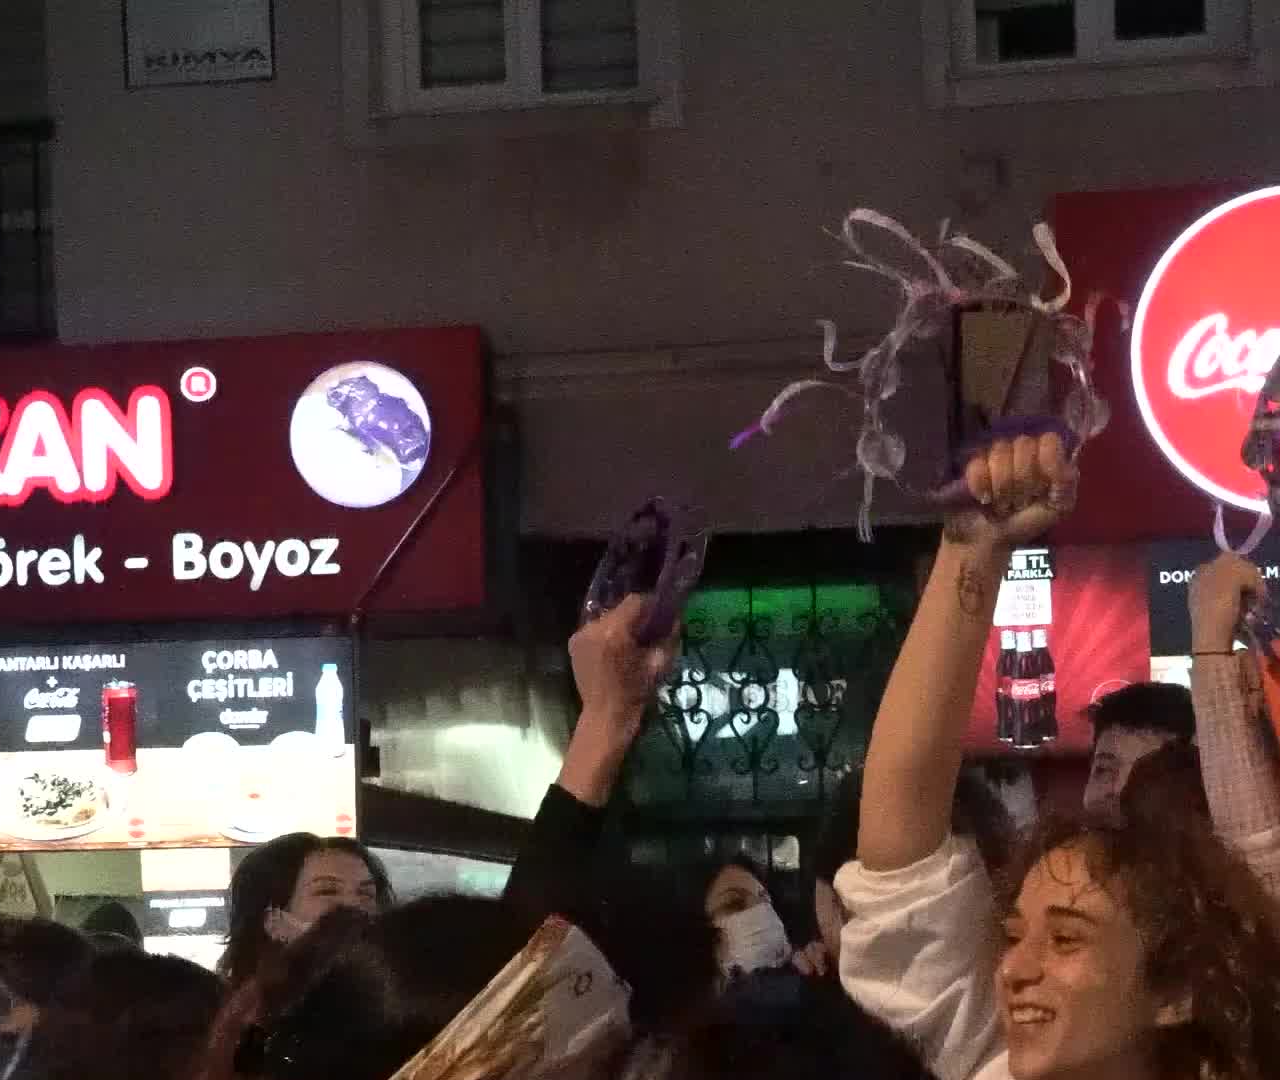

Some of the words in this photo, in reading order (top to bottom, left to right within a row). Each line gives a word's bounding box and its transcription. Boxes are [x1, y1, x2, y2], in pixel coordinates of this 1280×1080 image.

[172, 531, 341, 591] Boyoz
[1007, 569, 1054, 580] FARKLA
[62, 653, 126, 671] KAŞARLI
[201, 648, 279, 674] ÇORBA
[187, 671, 294, 703] ÇEŞİTLERİ
